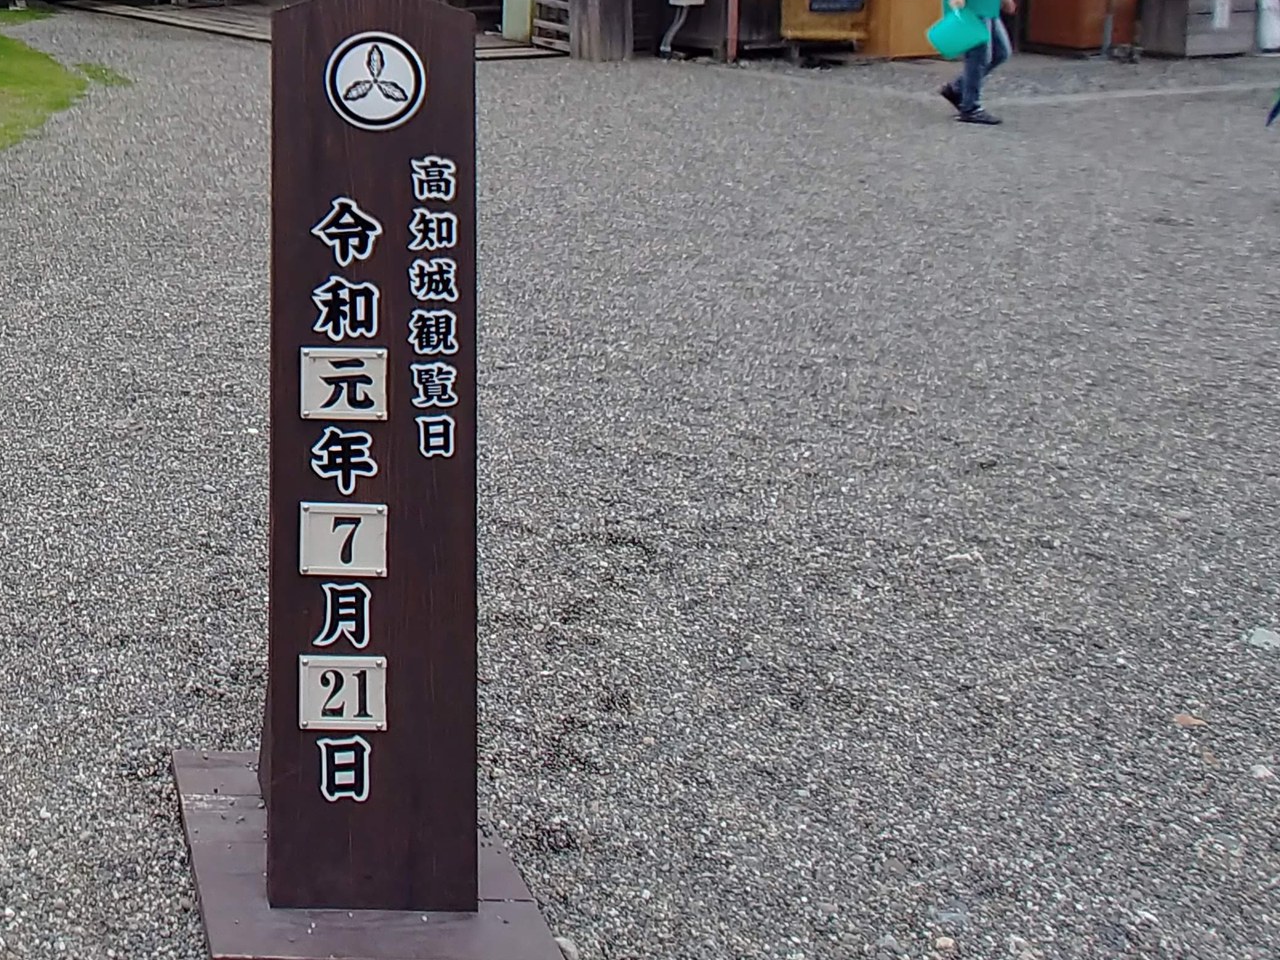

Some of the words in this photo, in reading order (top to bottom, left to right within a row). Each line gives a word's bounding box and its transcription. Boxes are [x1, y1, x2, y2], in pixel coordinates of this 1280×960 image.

[311, 197, 384, 802] 令和元年7月21日
[408, 156, 459, 458] 高知城観覧日
